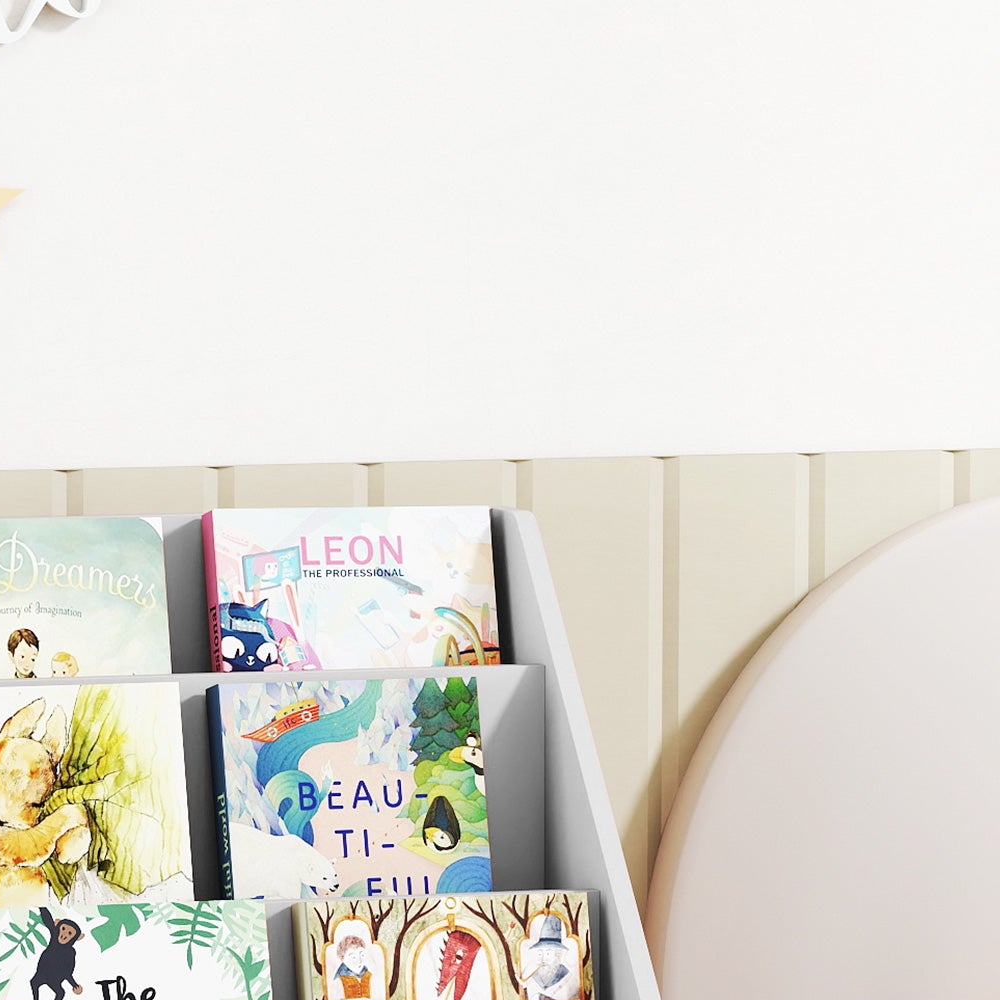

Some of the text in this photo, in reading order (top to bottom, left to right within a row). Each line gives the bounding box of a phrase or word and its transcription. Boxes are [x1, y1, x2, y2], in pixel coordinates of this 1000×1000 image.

[300, 535, 404, 566] LEON
[302, 567, 405, 579] THE PROFESSIONAL
[24, 602, 33, 613] of
[35, 601, 82, 618] Imagination
[297, 779, 428, 812] BEAU-
[334, 828, 395, 858] TI-
